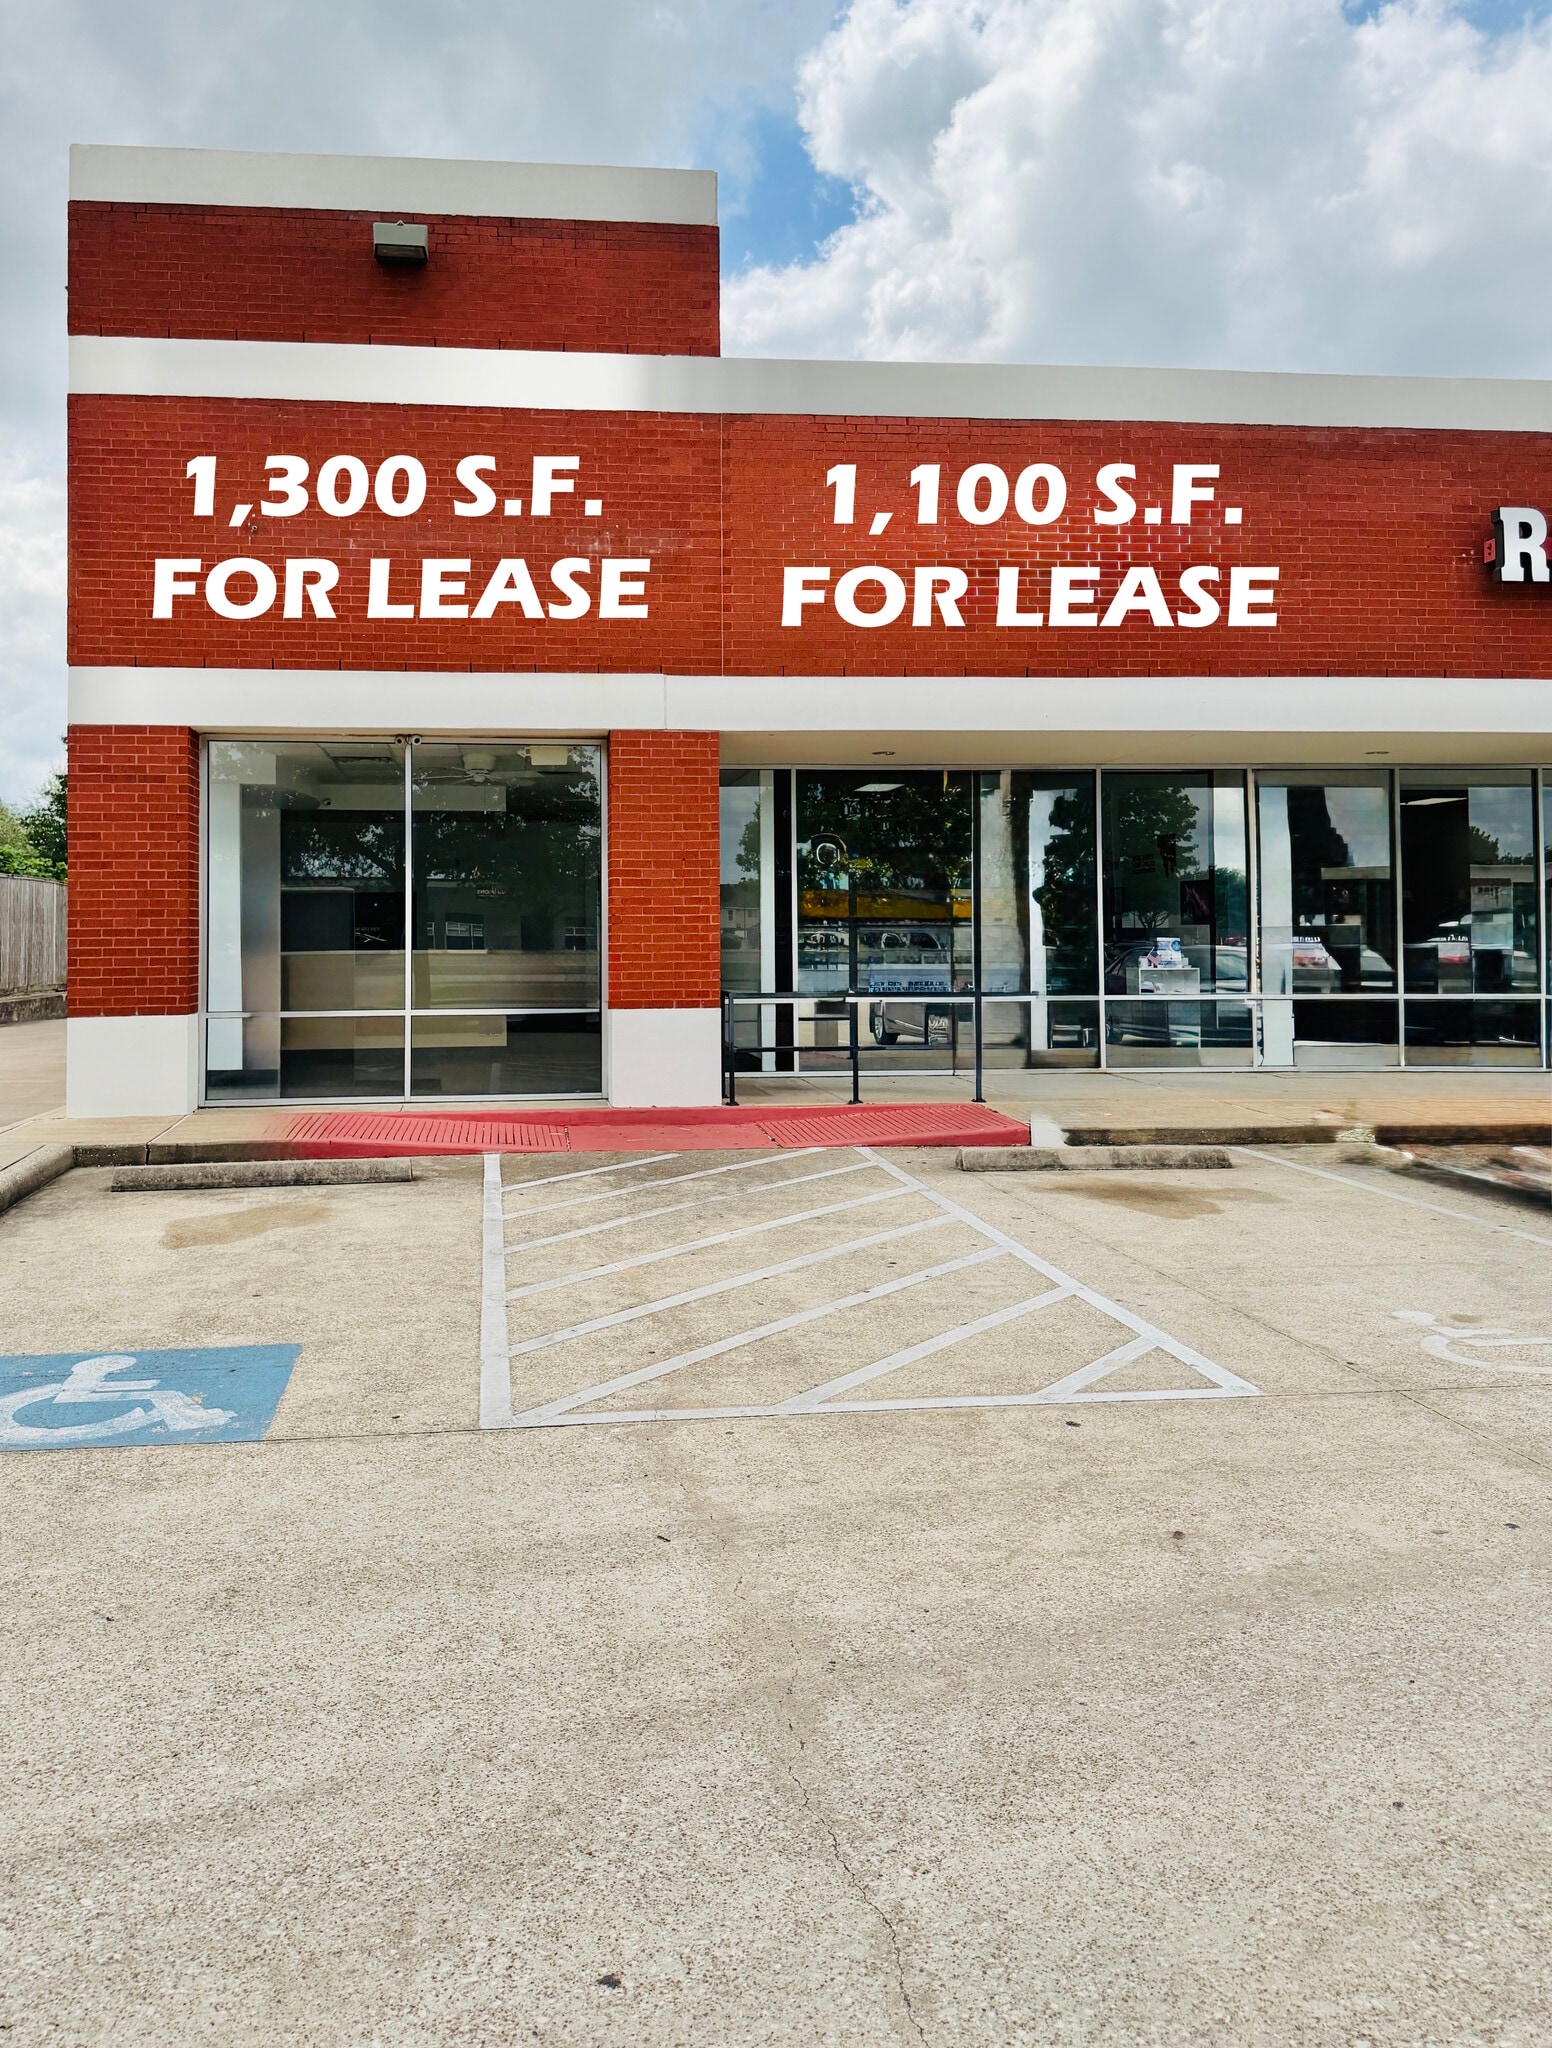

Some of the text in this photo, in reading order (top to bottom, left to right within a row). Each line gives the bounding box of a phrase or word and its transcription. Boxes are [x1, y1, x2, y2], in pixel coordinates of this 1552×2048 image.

[186, 454, 603, 527] 1,300 S.F.
[826, 462, 1243, 536] 1,100 S.F.
[152, 557, 651, 620] FOR LEASE
[781, 565, 1280, 628] FOR LEASE
